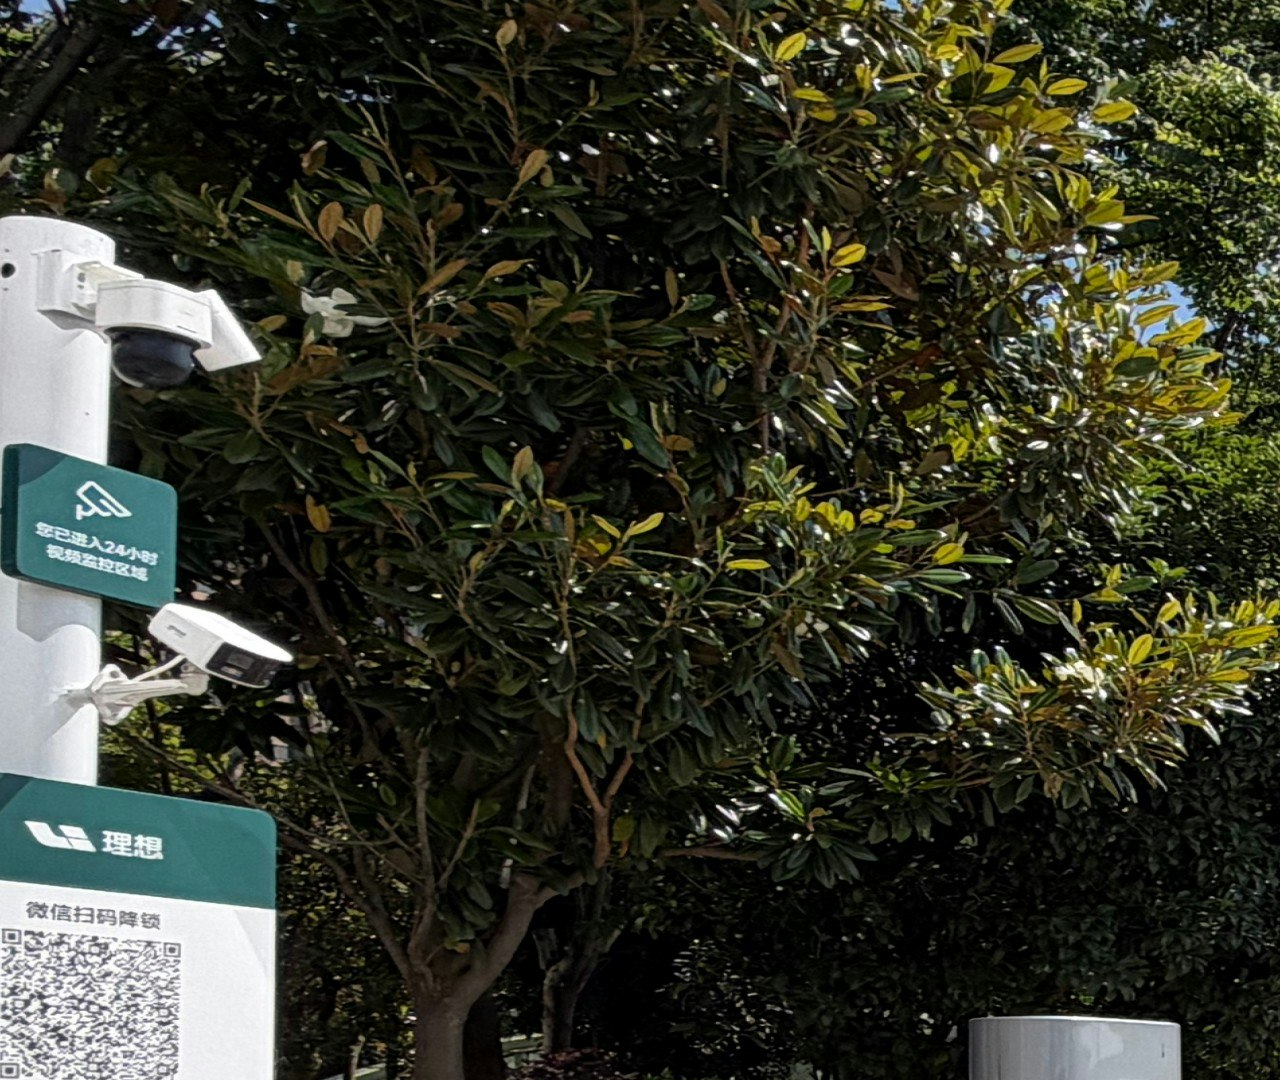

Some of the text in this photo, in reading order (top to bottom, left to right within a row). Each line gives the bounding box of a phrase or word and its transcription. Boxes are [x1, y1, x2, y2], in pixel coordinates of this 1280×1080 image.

[45, 544, 149, 582] 视频监控区域
[102, 829, 164, 861] 理想
[26, 901, 162, 931] 微信扫码降锁
